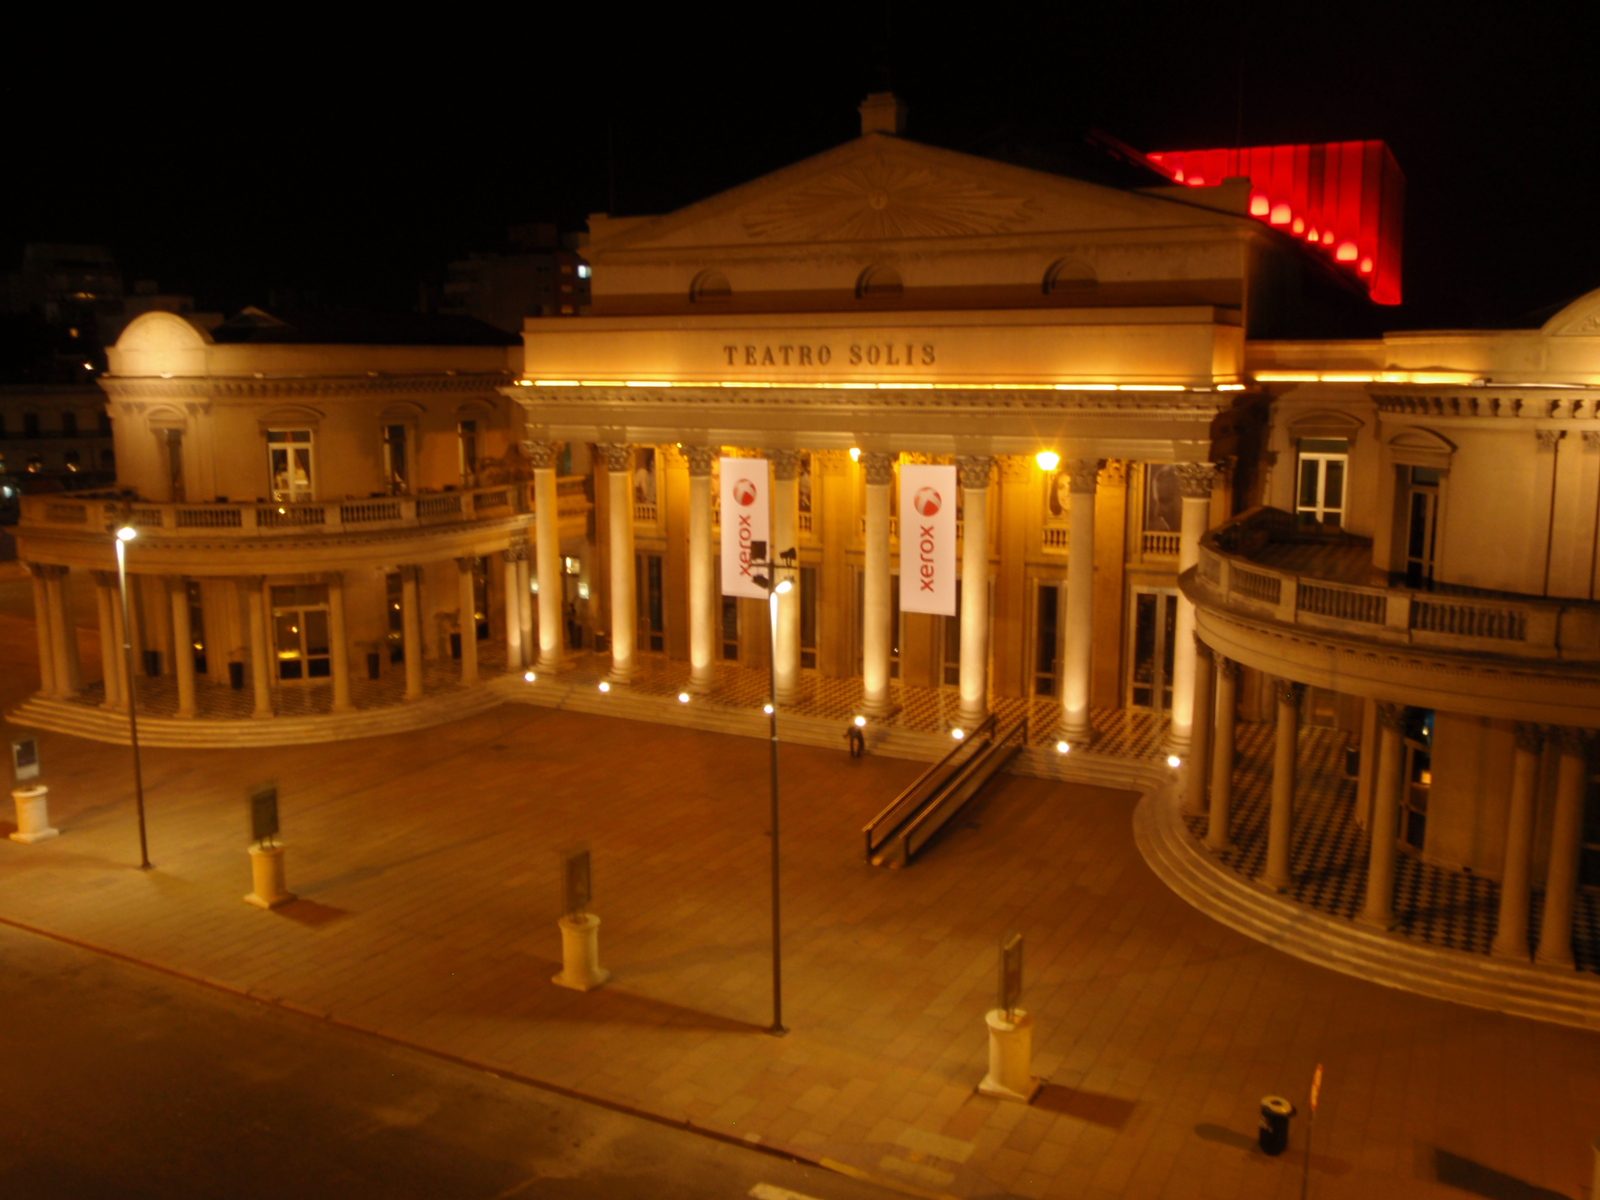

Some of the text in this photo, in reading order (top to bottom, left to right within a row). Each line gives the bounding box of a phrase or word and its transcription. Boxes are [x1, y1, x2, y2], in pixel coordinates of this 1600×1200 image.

[723, 344, 936, 366] TEATRO SOLIS
[738, 514, 751, 577] xerox
[920, 525, 935, 593] xerox
